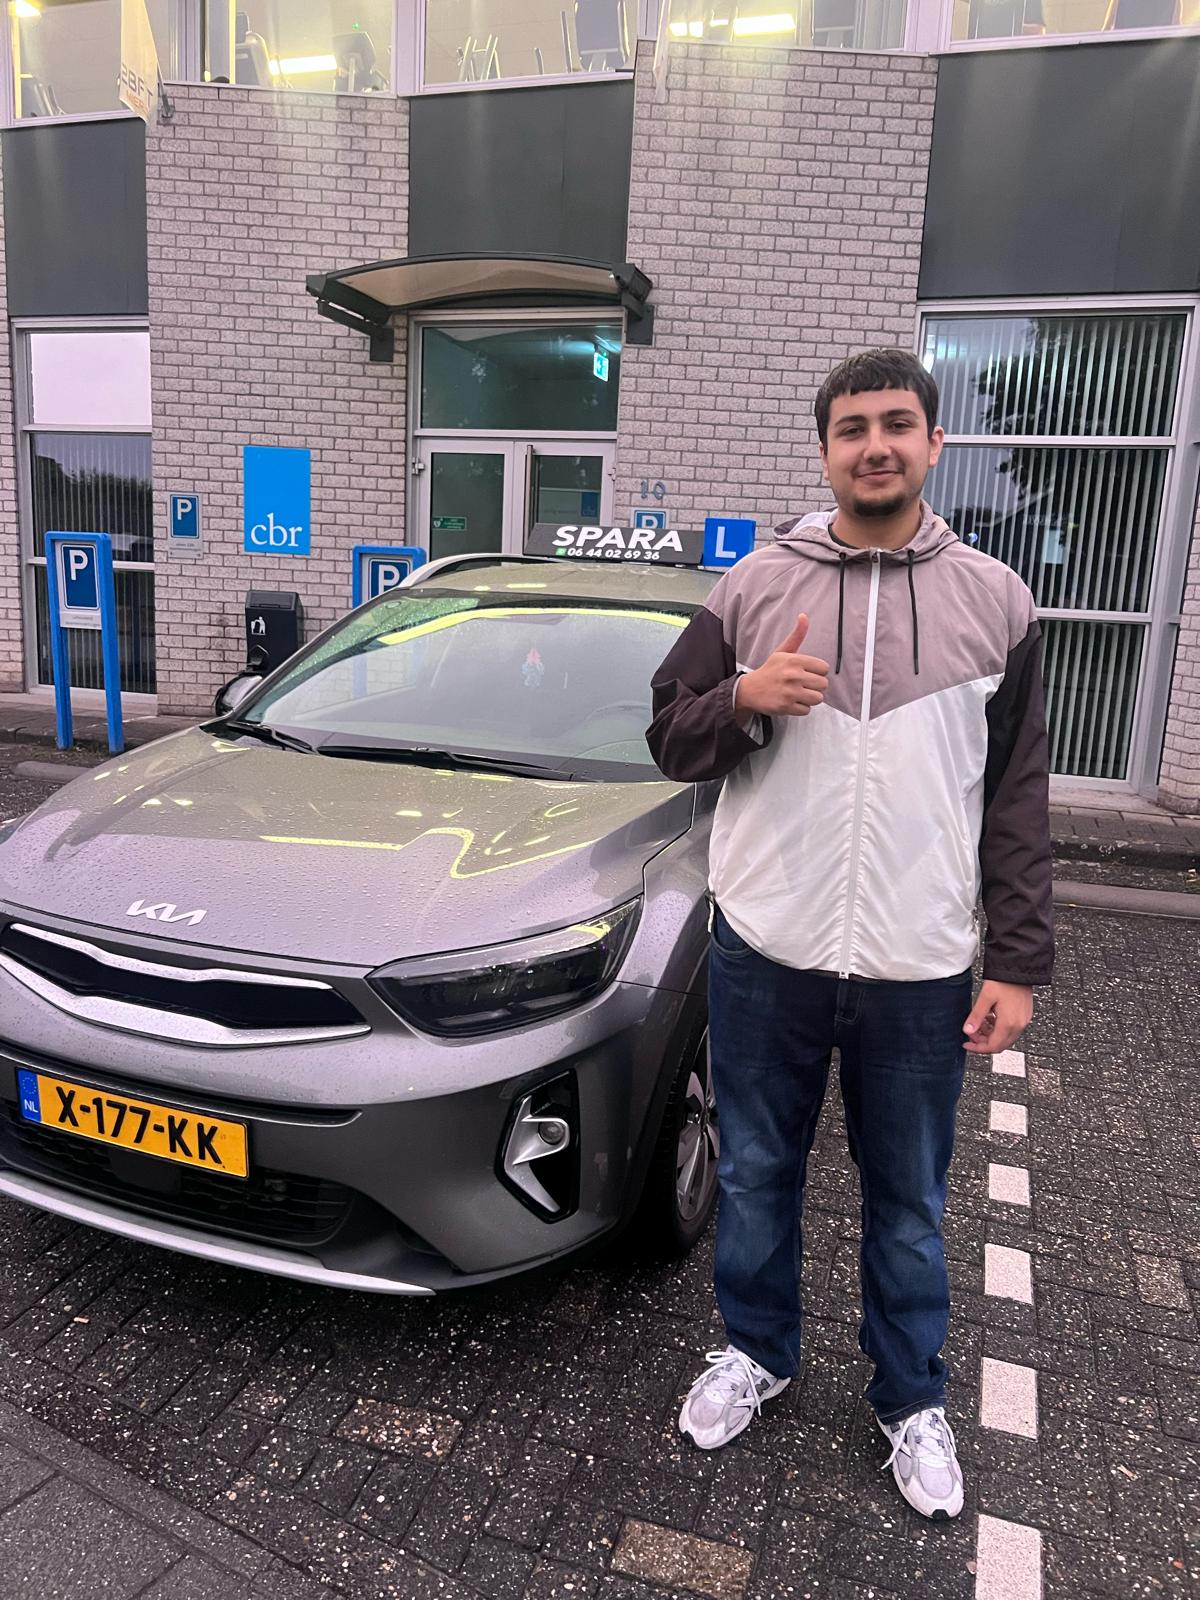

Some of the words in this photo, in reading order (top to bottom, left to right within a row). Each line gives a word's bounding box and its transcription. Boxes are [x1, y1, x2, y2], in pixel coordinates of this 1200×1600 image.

[640, 480, 666, 501] 10
[176, 498, 193, 520] P
[250, 512, 303, 547] cbr
[552, 526, 683, 552] SPARA
[715, 526, 737, 559] L
[69, 549, 89, 581] P
[567, 547, 583, 557] 06
[585, 548, 603, 558] 44
[604, 549, 622, 559] 02
[623, 550, 642, 560] 69
[643, 551, 661, 561] 36
[378, 564, 400, 596] P
[125, 899, 208, 926] KIA
[23, 1098, 39, 1113] NL
[55, 1086, 223, 1165] X-177-KK
